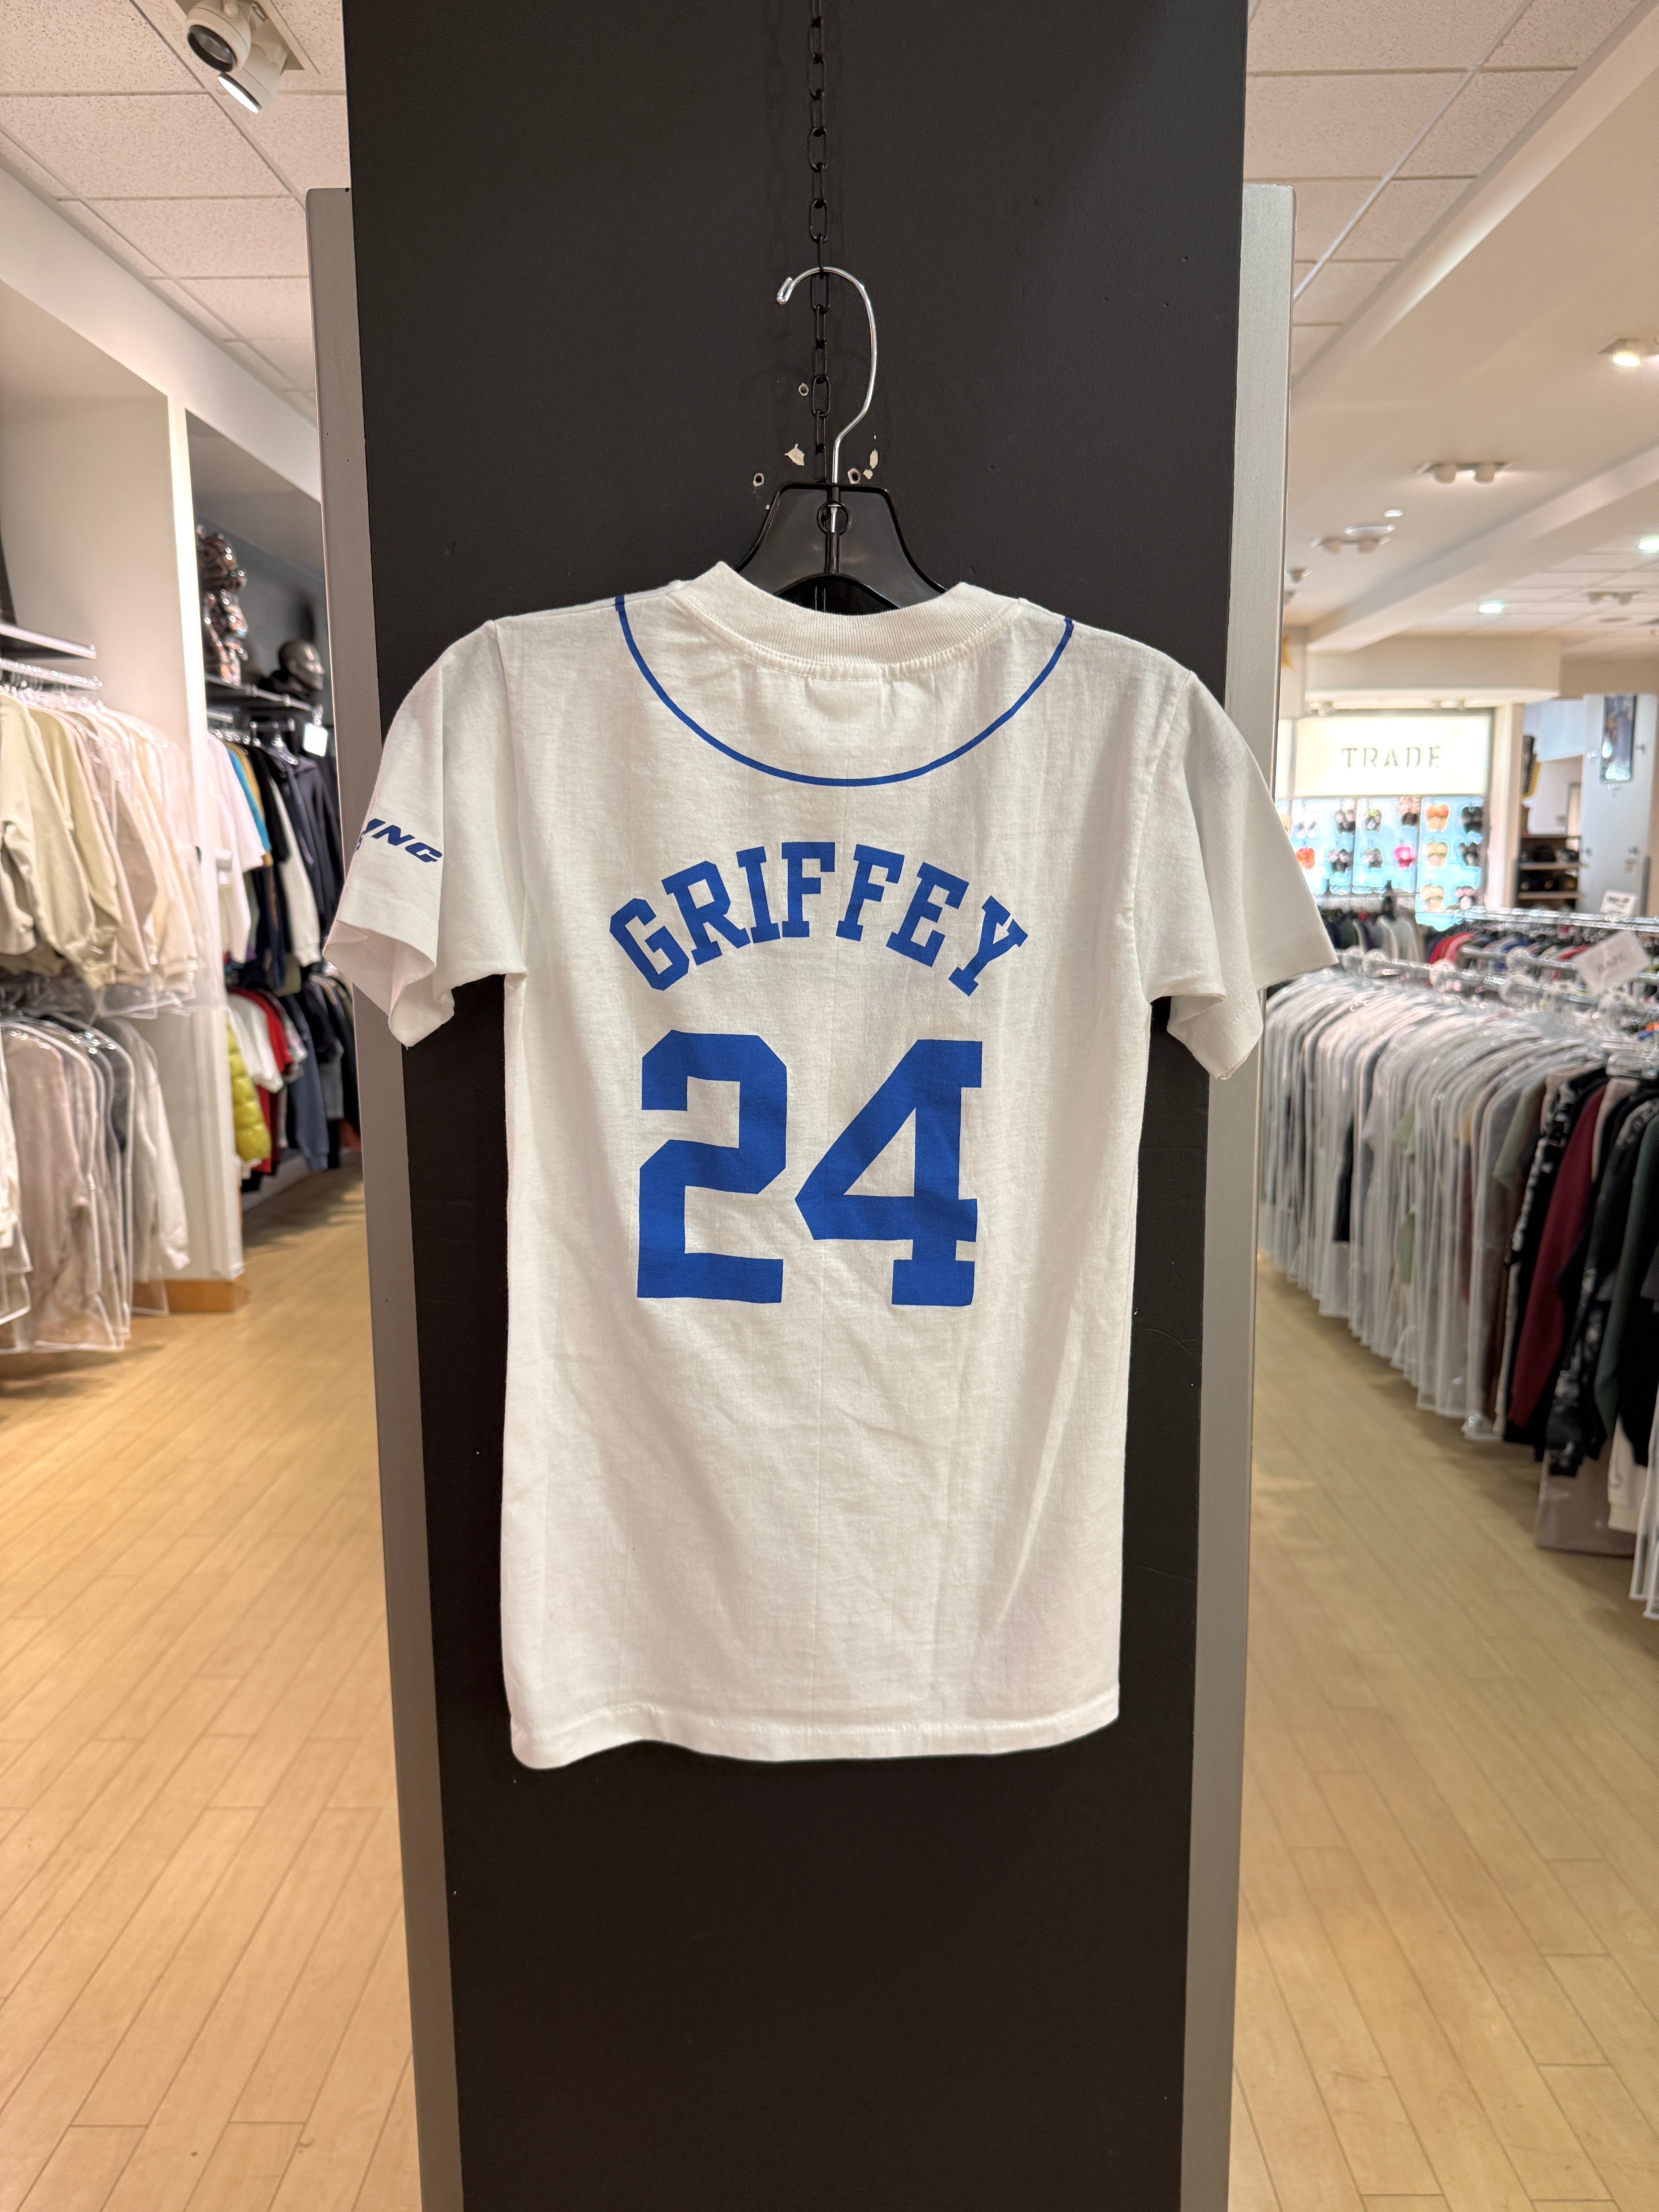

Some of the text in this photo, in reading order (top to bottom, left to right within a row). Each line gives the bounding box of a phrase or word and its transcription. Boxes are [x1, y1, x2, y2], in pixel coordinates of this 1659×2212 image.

[1341, 745, 1441, 768] TRADE
[610, 842, 1028, 996] GRIFFEY
[637, 1029, 982, 1307] 24
